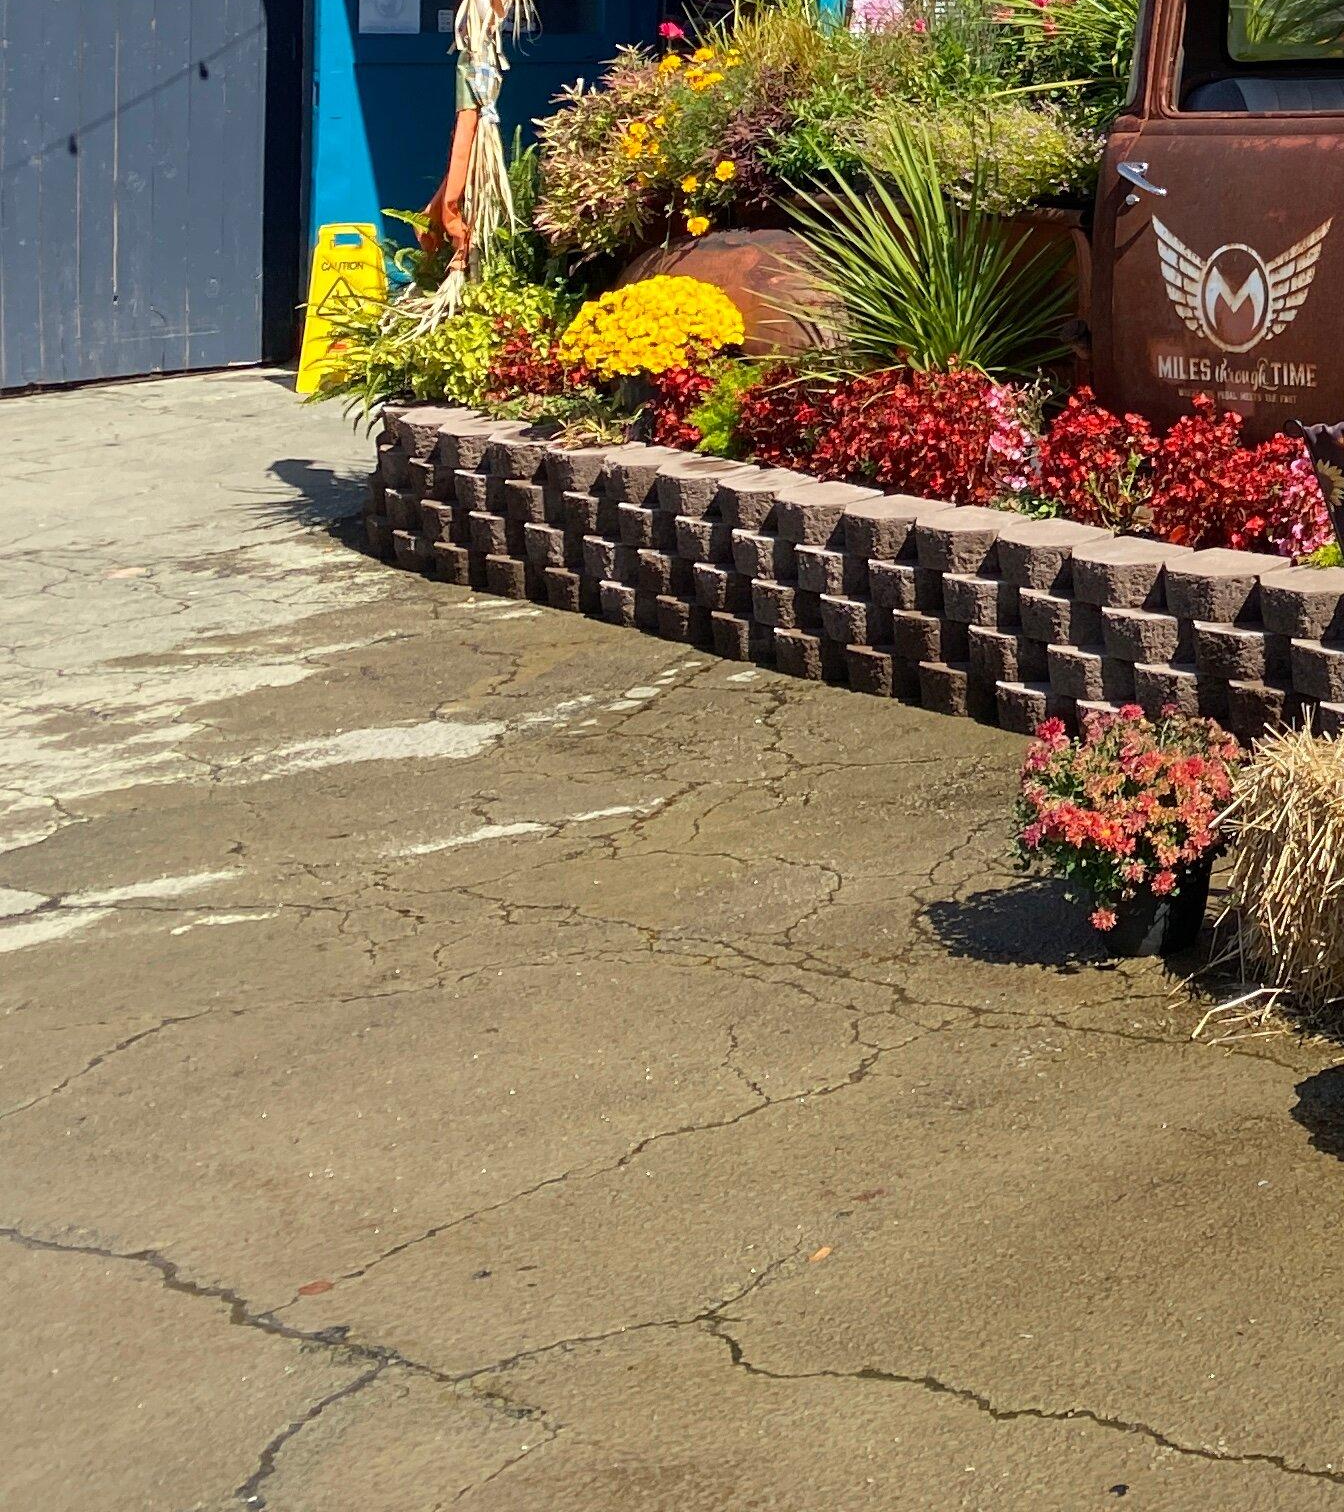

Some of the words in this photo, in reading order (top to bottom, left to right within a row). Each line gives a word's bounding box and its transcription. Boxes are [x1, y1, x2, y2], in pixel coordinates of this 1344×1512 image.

[322, 261, 364, 271] CAUTION
[1205, 265, 1265, 330] M
[1158, 355, 1211, 382] MILES
[1215, 357, 1279, 391] through
[1270, 362, 1318, 388] TIME
